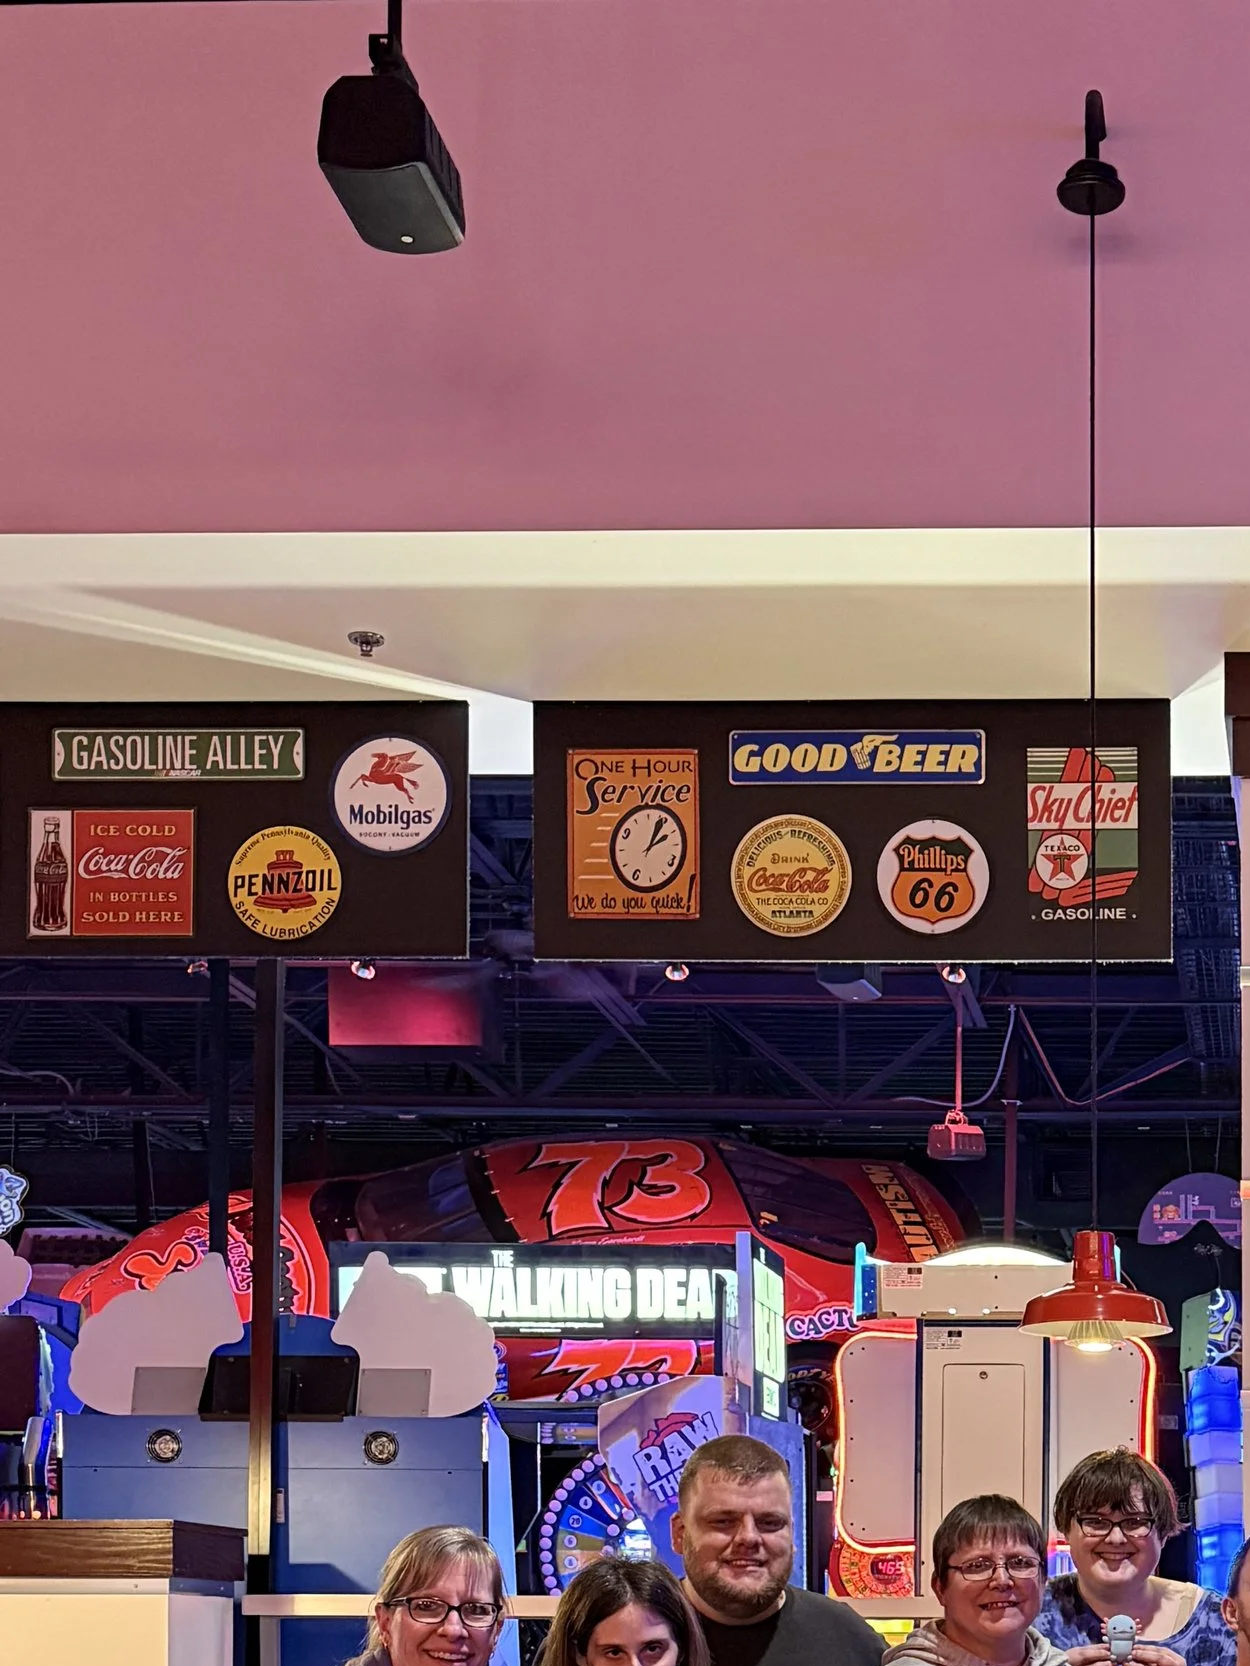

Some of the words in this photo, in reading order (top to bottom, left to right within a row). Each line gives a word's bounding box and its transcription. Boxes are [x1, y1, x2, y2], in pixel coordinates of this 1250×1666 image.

[71, 735, 198, 770] GASOLINE
[206, 734, 285, 770] ALLEY
[733, 743, 847, 773] GOOD
[873, 744, 979, 773] BEER
[631, 758, 693, 777] HOUR
[575, 776, 692, 815] Service
[1028, 785, 1072, 828] Sky
[1073, 784, 1138, 823] Chief
[90, 825, 120, 836] ICE
[125, 825, 176, 836] COLD
[349, 804, 433, 830] Mobilgas
[78, 847, 188, 879] Coca-Cola
[746, 830, 783, 867] DELICIOUS
[790, 829, 836, 867] REFRESHING
[770, 853, 810, 864] DRINK
[899, 844, 965, 875] Phillips
[1044, 844, 1081, 852] TEXACO
[90, 892, 103, 902] IN
[110, 892, 178, 902] BOTTLES
[233, 869, 338, 898] PENNZOIL
[909, 878, 959, 913] 66
[81, 911, 130, 922] SOLD
[135, 911, 184, 922] HERE
[573, 894, 596, 910] We
[601, 893, 617, 910] do
[622, 896, 646, 914] you
[756, 897, 771, 906] THE
[772, 897, 794, 906] COCA
[795, 897, 816, 906] COLA
[235, 901, 261, 930] SAFE
[262, 897, 336, 938] LUBRICATION
[520, 1138, 713, 1238] 73
[491, 1250, 514, 1267] THE
[452, 1267, 632, 1319] WALKING
[633, 1411, 720, 1485] RAW
